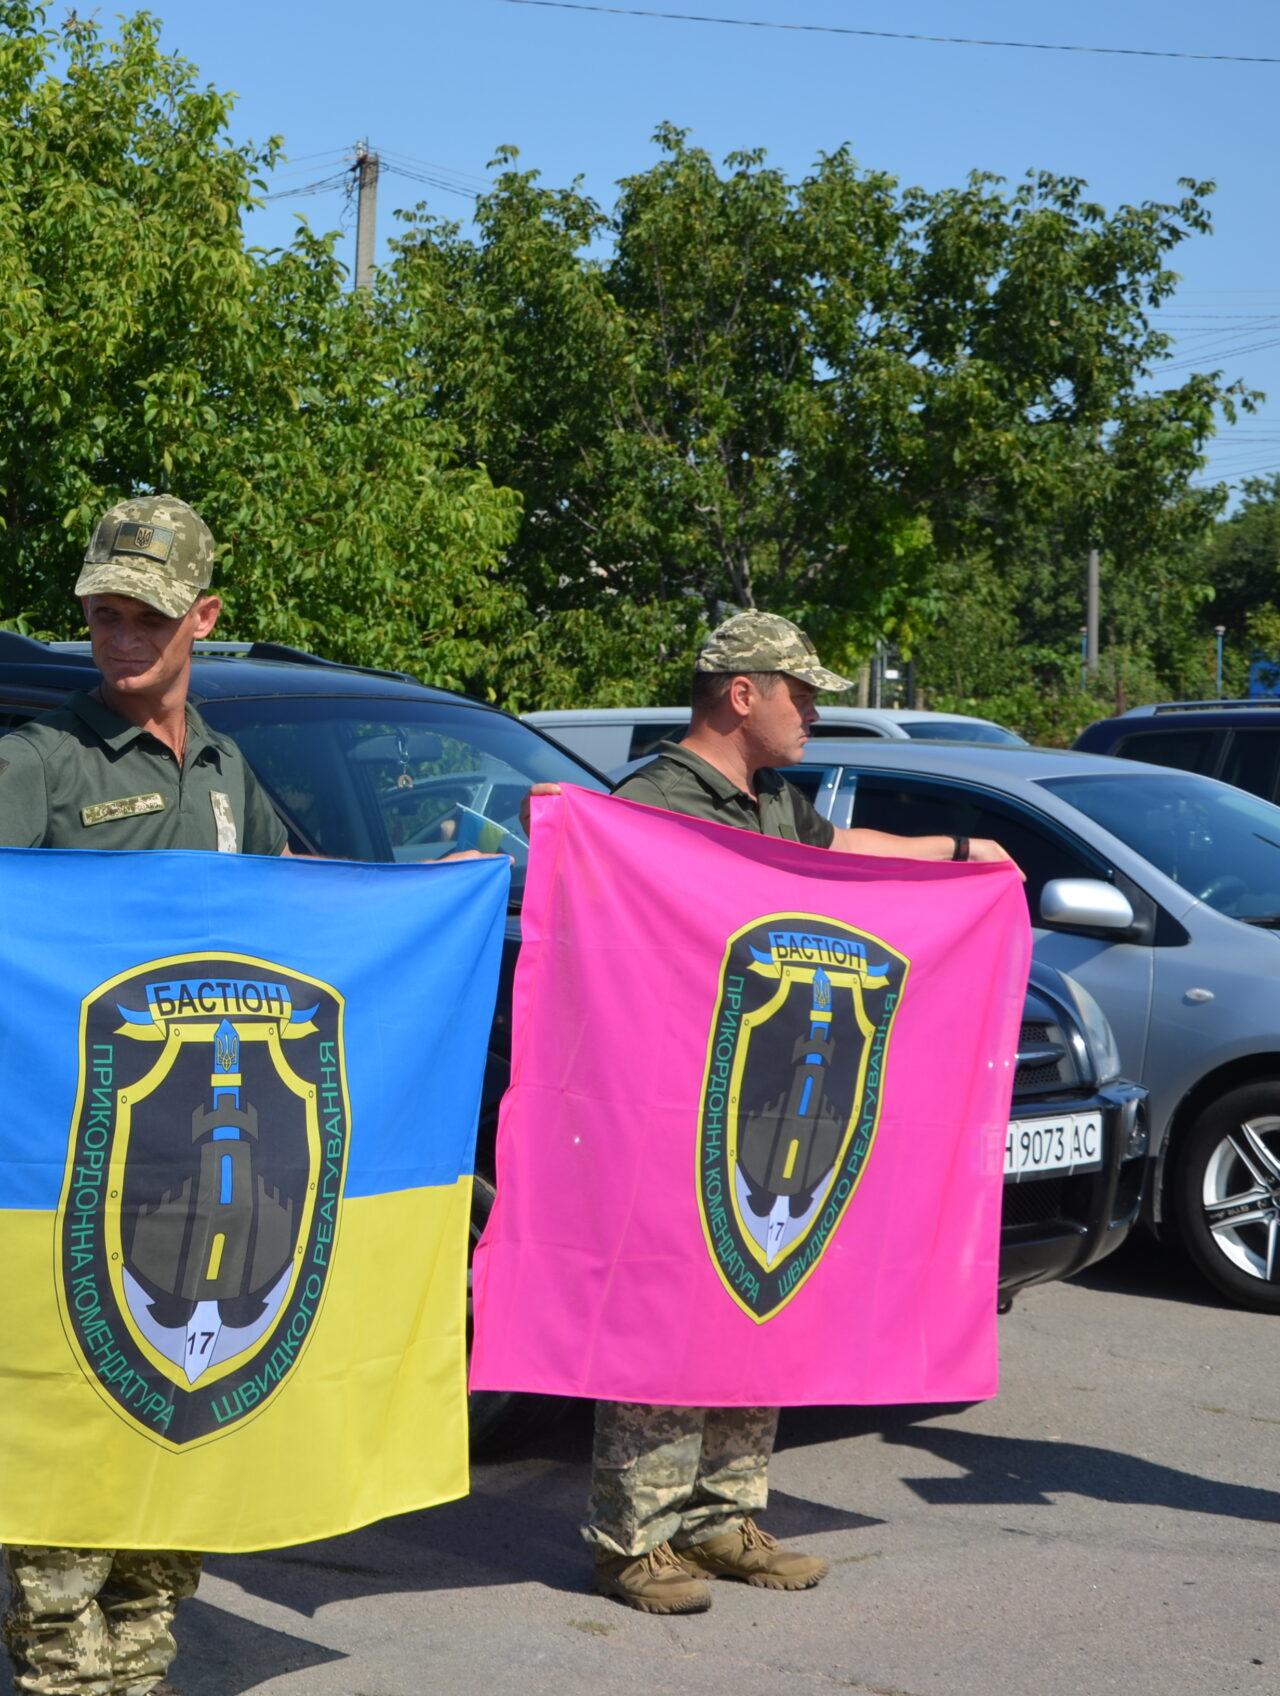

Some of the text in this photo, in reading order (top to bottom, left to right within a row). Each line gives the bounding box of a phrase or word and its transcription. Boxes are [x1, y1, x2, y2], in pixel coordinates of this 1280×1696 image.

[154, 981, 285, 1017] БАСТІОН
[773, 934, 862, 969] БАСТІОН
[705, 975, 761, 1304] ПРИКОРДОННА КОМЕНДАТУРА
[777, 993, 897, 1299] ШВИДКОГО РЕАГУВАННЯ
[1020, 1126, 1065, 1167] 9073
[1071, 1122, 1097, 1159] AC
[69, 1044, 176, 1431] ПРИКОРДОННА КОМЕНДАТУРА
[210, 1041, 343, 1425] ШВИДКОГО РЕАГУВАННЯ
[186, 1330, 216, 1357] 17
